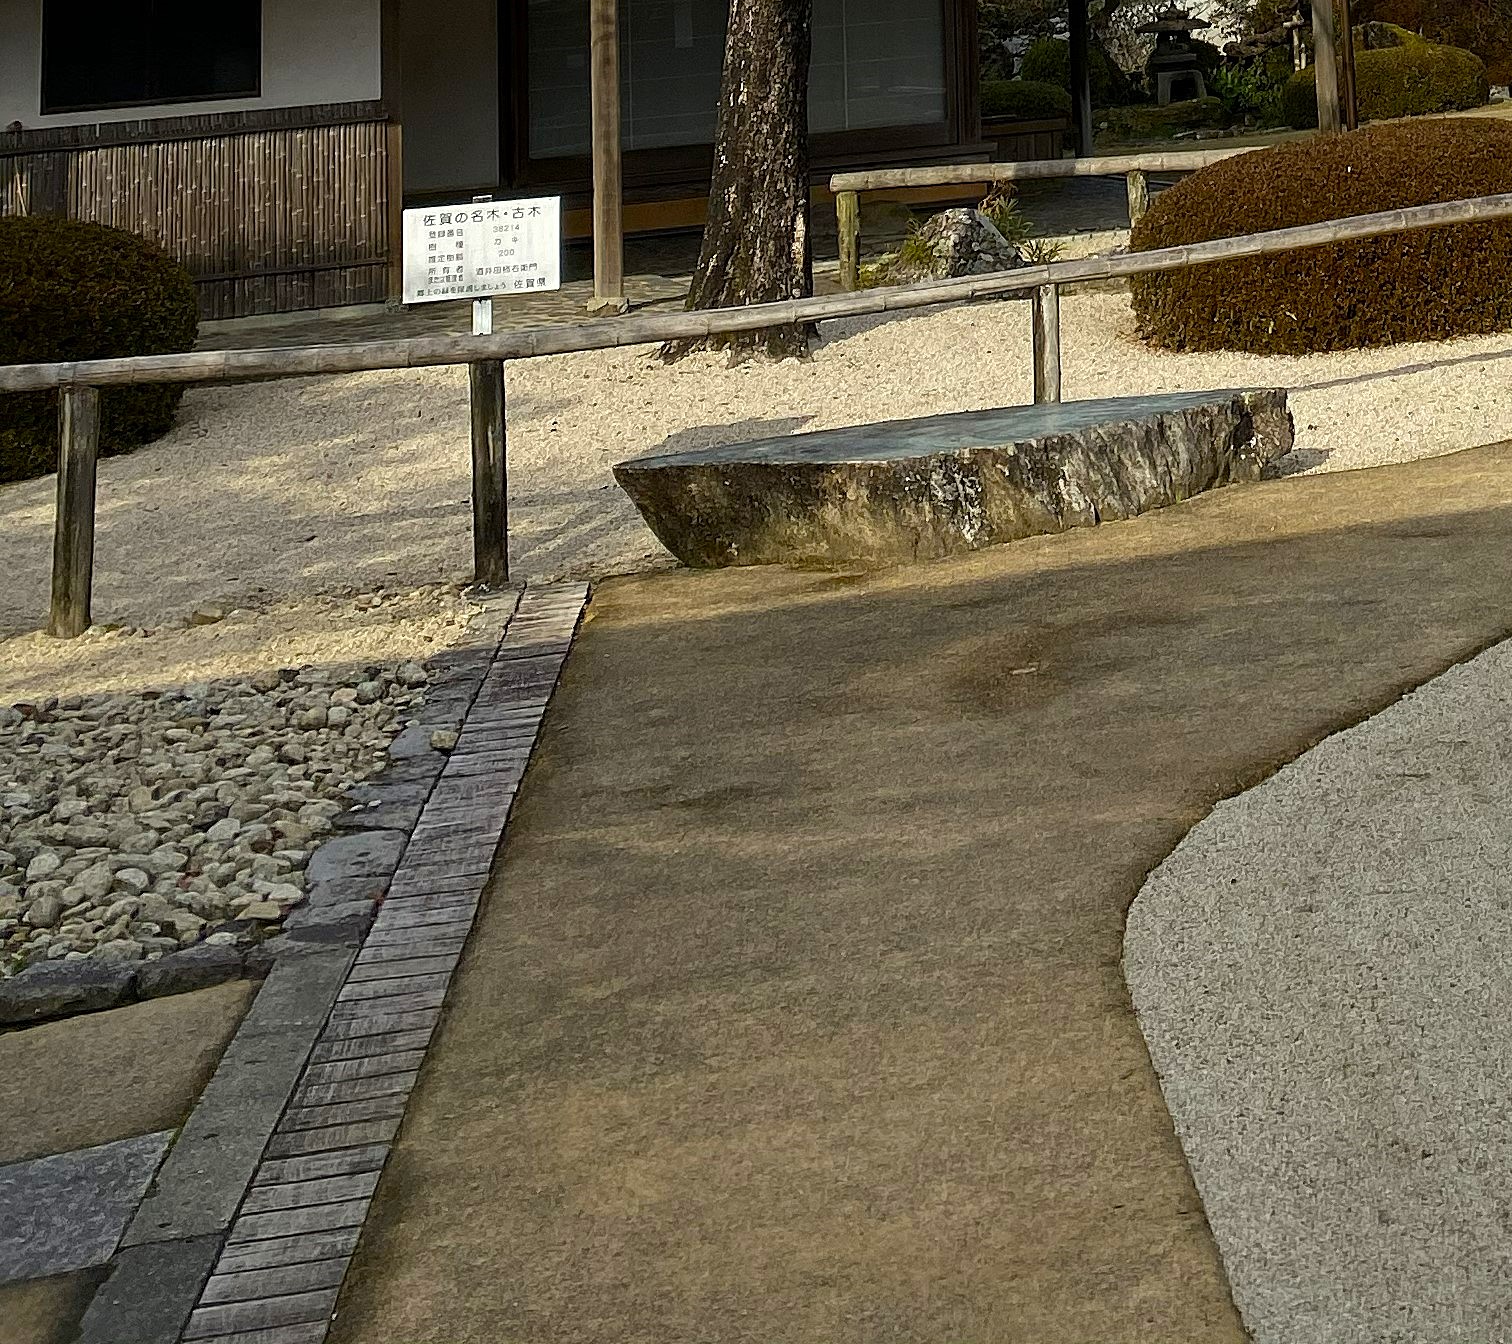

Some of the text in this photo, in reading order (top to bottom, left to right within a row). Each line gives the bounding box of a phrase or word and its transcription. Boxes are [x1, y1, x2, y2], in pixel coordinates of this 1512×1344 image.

[423, 206, 541, 226] 佐賀の名木・古木
[492, 224, 520, 233] 38214
[498, 248, 515, 257] 200
[513, 277, 546, 289] 佐賀県
